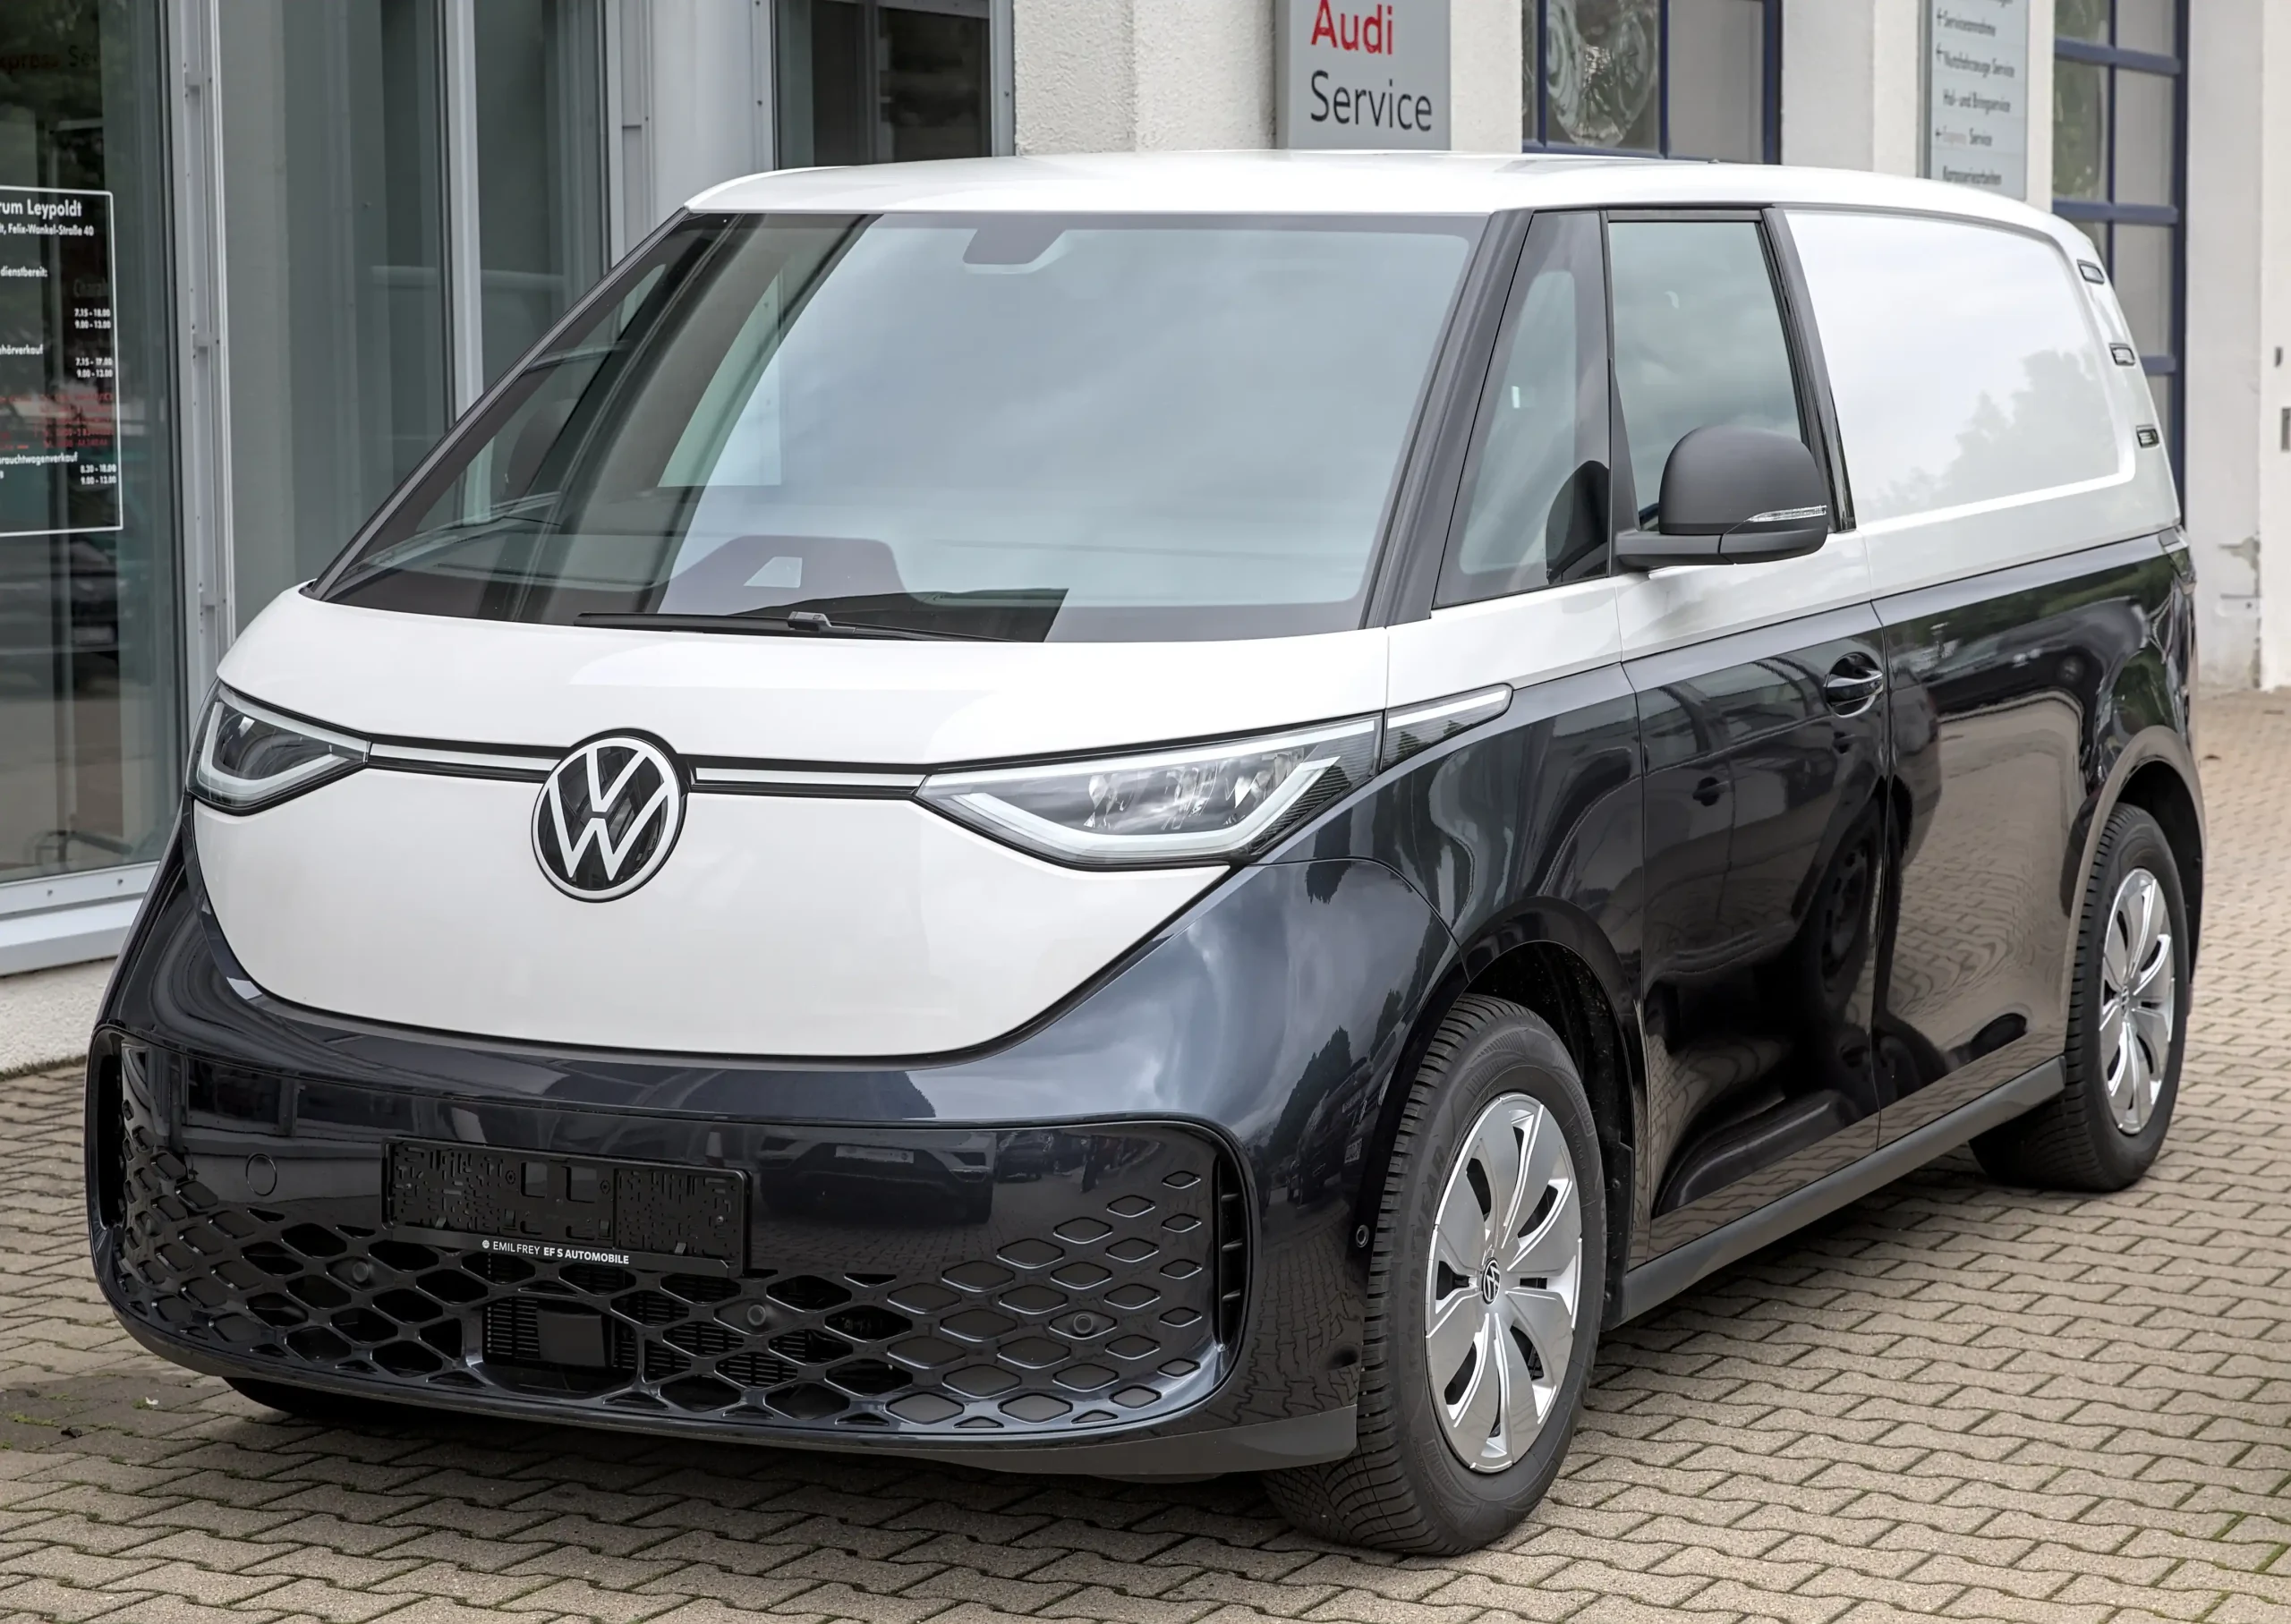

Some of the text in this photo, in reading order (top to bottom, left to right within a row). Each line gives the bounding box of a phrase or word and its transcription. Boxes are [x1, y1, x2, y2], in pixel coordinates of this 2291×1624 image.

[1311, 0, 1393, 55] Audi
[1310, 70, 1432, 132] Service
[27, 198, 82, 220] Leypoldt
[8, 223, 83, 236] Felix-Wankel-Straße
[84, 225, 95, 236] 40
[1, 265, 48, 277] dienstbereit:
[0, 344, 43, 355] hörverkauf
[0, 451, 78, 466] rauchtwagenverkauf
[493, 1240, 629, 1264] EMIL FREY EF S AUTOMOBILE
